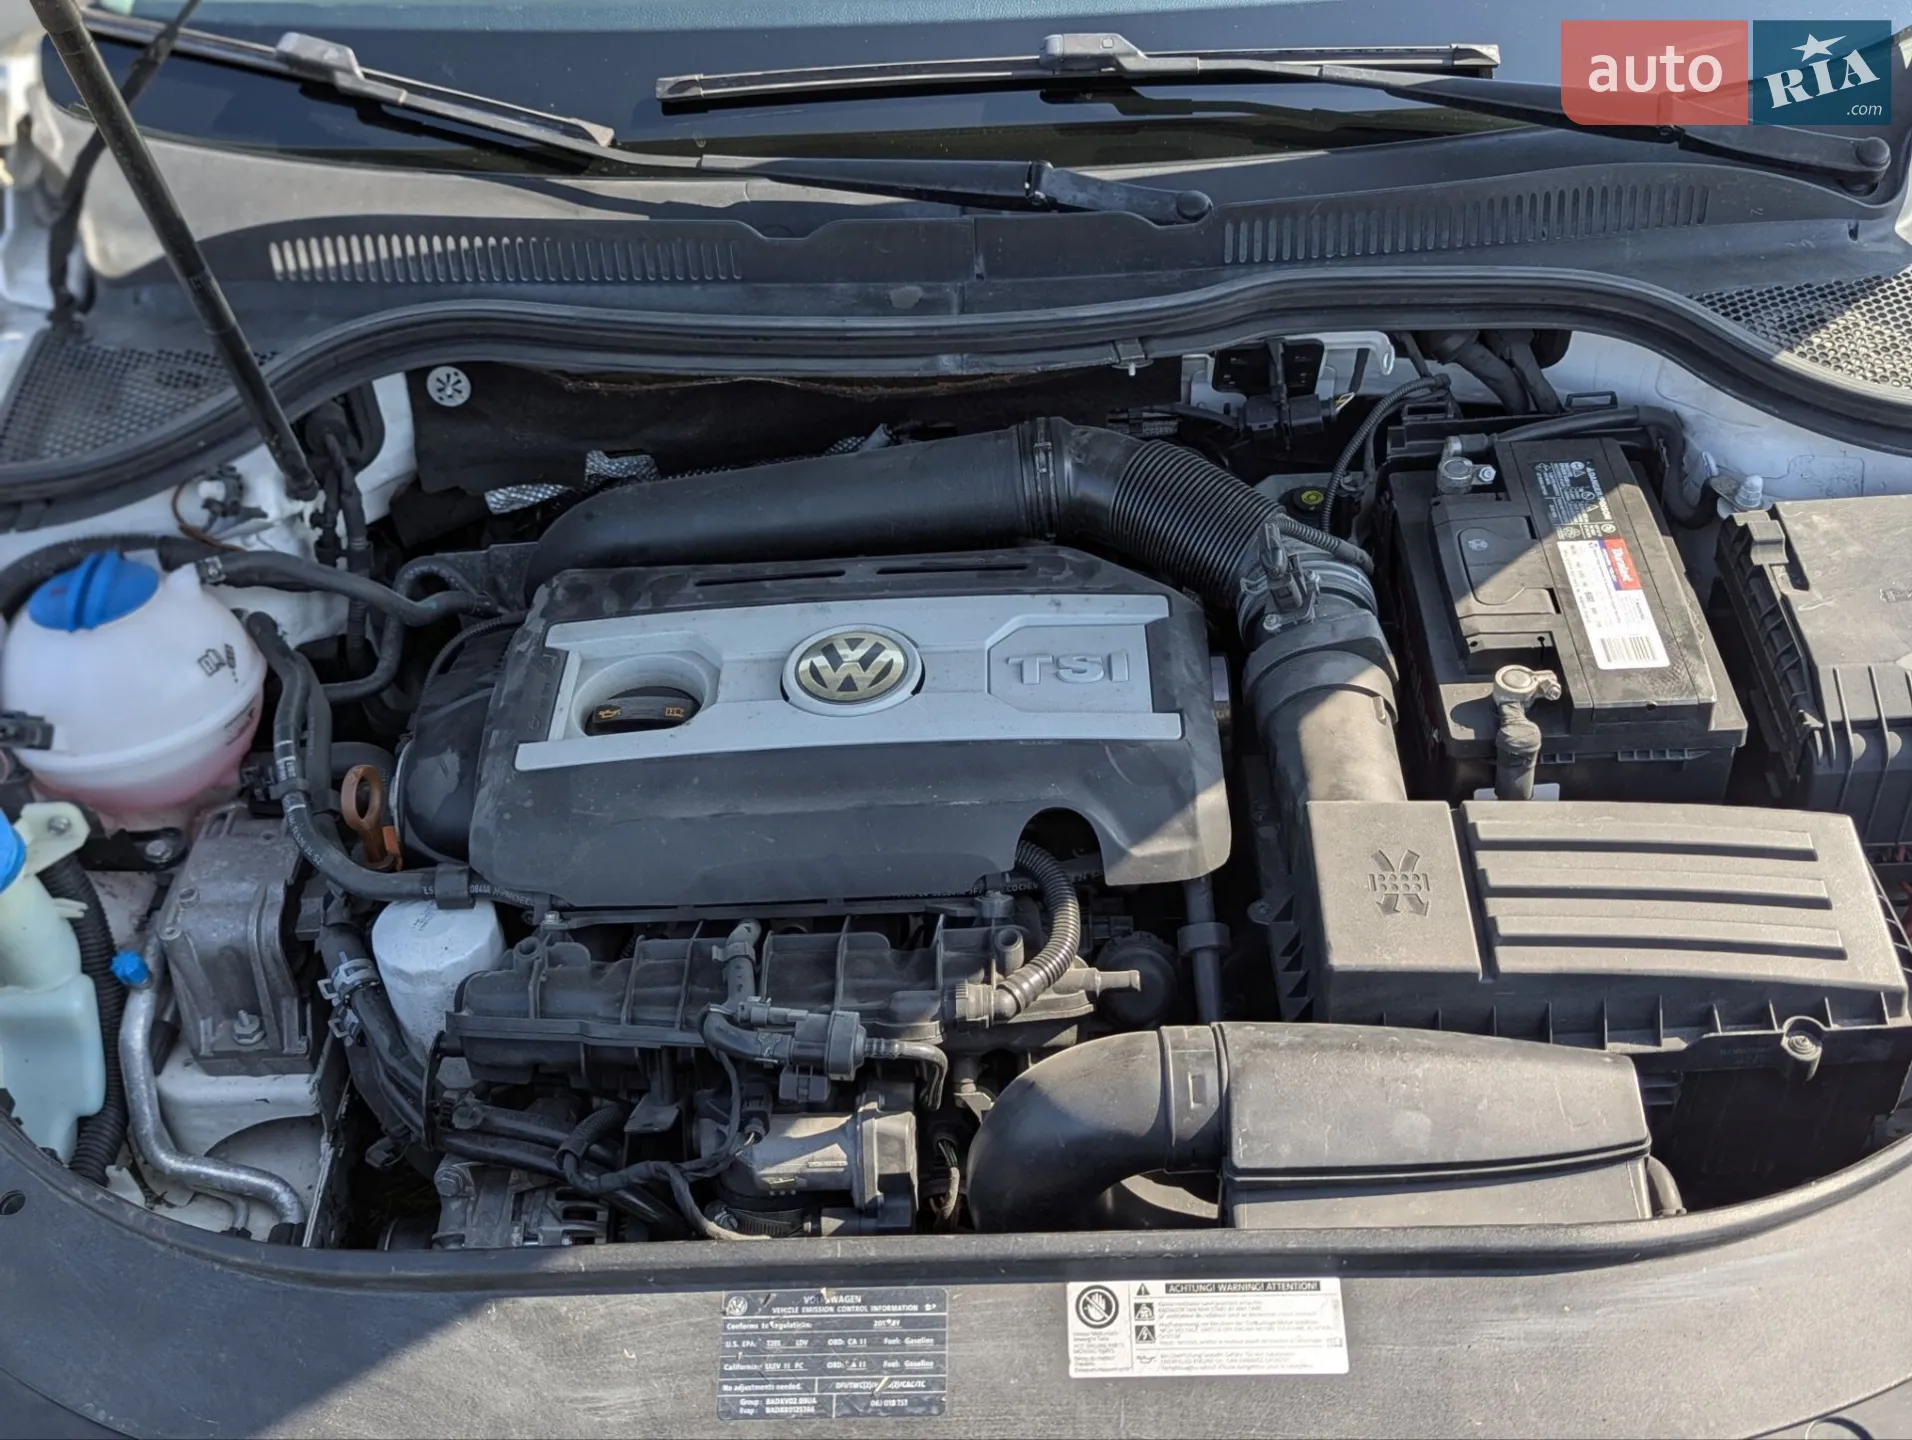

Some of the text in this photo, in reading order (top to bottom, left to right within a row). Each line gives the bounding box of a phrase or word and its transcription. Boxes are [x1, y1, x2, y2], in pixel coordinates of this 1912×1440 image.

[1007, 651, 1130, 684] TSI
[1168, 1281, 1318, 1293] ACHTUNG! WARNING! ATTENTION!
[772, 1306, 799, 1314] VEHICLE
[802, 1305, 835, 1313] EMISSION
[837, 1304, 868, 1313] CONTROL
[870, 1304, 918, 1312] INFORMATION
[726, 1322, 759, 1330] Conforms
[828, 1338, 845, 1346] OBD:
[847, 1338, 857, 1346] CA
[884, 1337, 901, 1345] Fuel:
[904, 1336, 935, 1345] Gasoline
[826, 1361, 845, 1369] OBD:
[883, 1360, 900, 1368] Fuel:
[904, 1360, 934, 1368] Gasoline
[722, 1382, 803, 1393] No adjustments needed.
